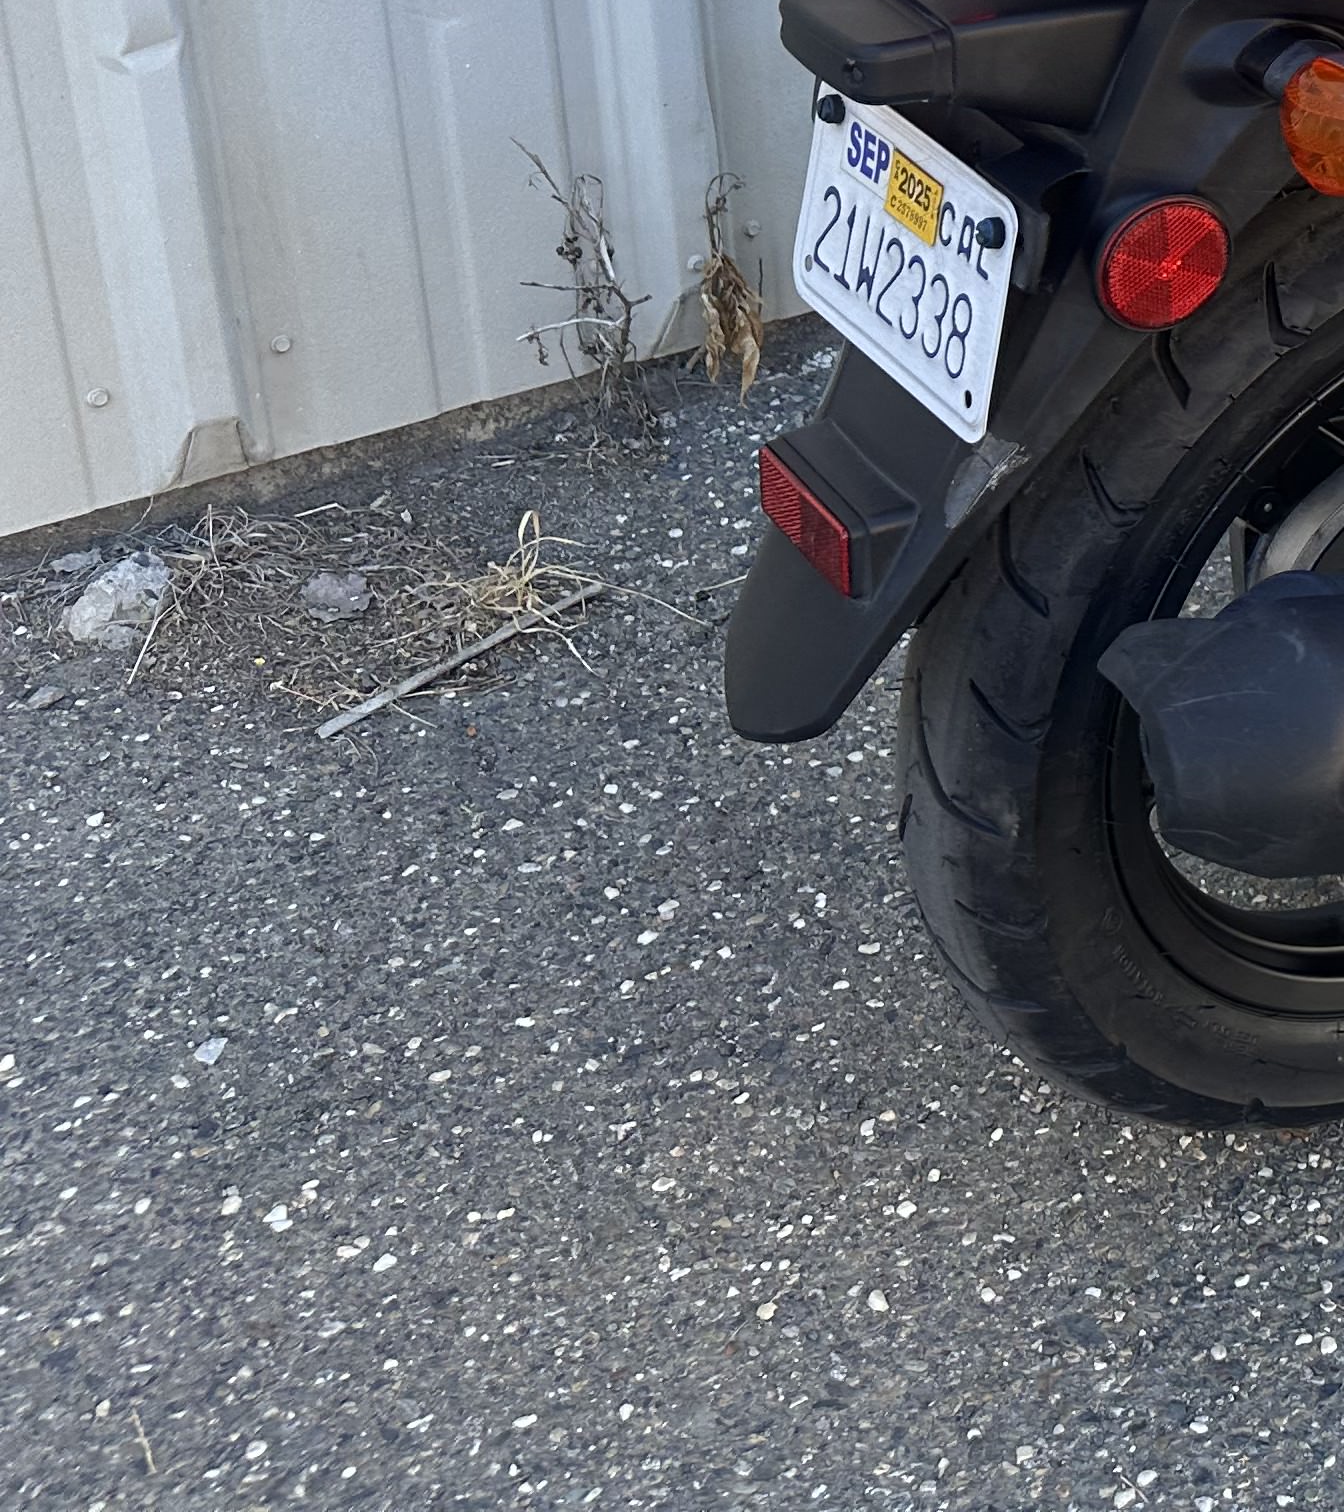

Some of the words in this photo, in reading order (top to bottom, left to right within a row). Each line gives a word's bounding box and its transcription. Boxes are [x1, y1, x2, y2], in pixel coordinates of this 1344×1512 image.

[847, 121, 891, 184] SEP
[897, 166, 932, 212] 2025
[813, 185, 973, 380] 21W2338
